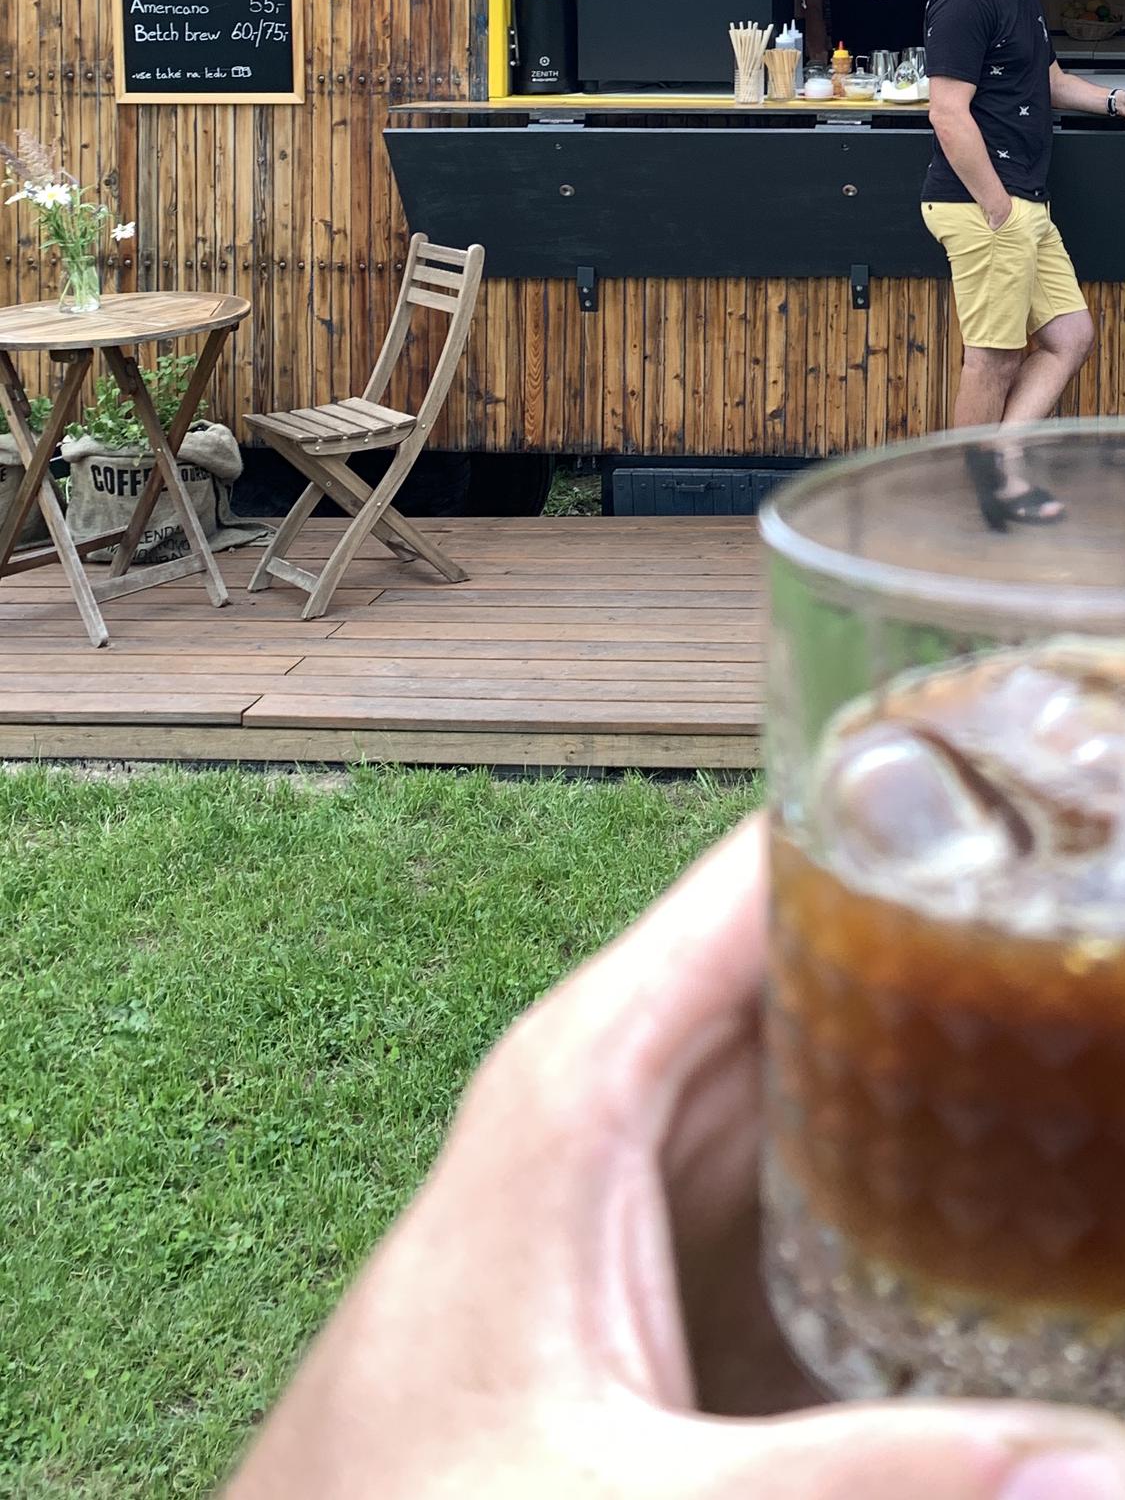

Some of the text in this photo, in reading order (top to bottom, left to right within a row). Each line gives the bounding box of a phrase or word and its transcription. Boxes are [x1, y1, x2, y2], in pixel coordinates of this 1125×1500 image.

[184, 21, 221, 42] brew
[186, 71, 201, 79] na
[204, 67, 228, 79] ledu
